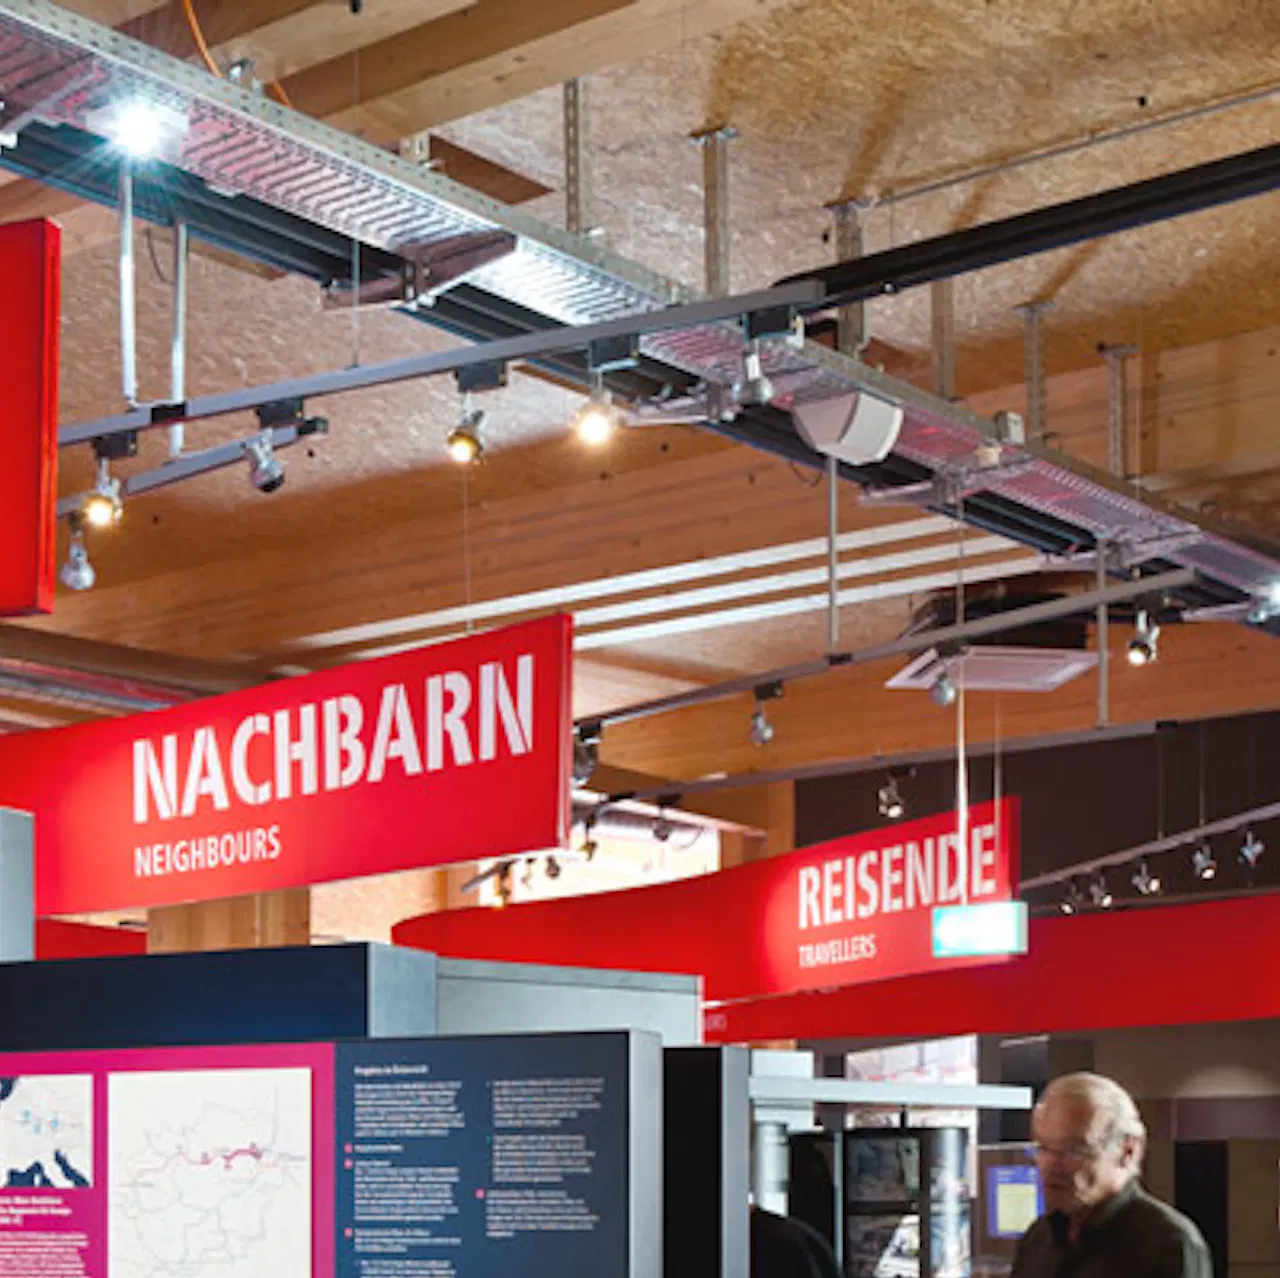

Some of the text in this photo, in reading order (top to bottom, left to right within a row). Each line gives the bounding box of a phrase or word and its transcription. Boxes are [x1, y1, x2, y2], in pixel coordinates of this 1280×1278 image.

[132, 653, 536, 825] NACHBARN
[135, 824, 281, 878] NEIGHBOURS
[797, 824, 997, 930] REISENDE
[798, 932, 877, 969] TRAVELLERS
